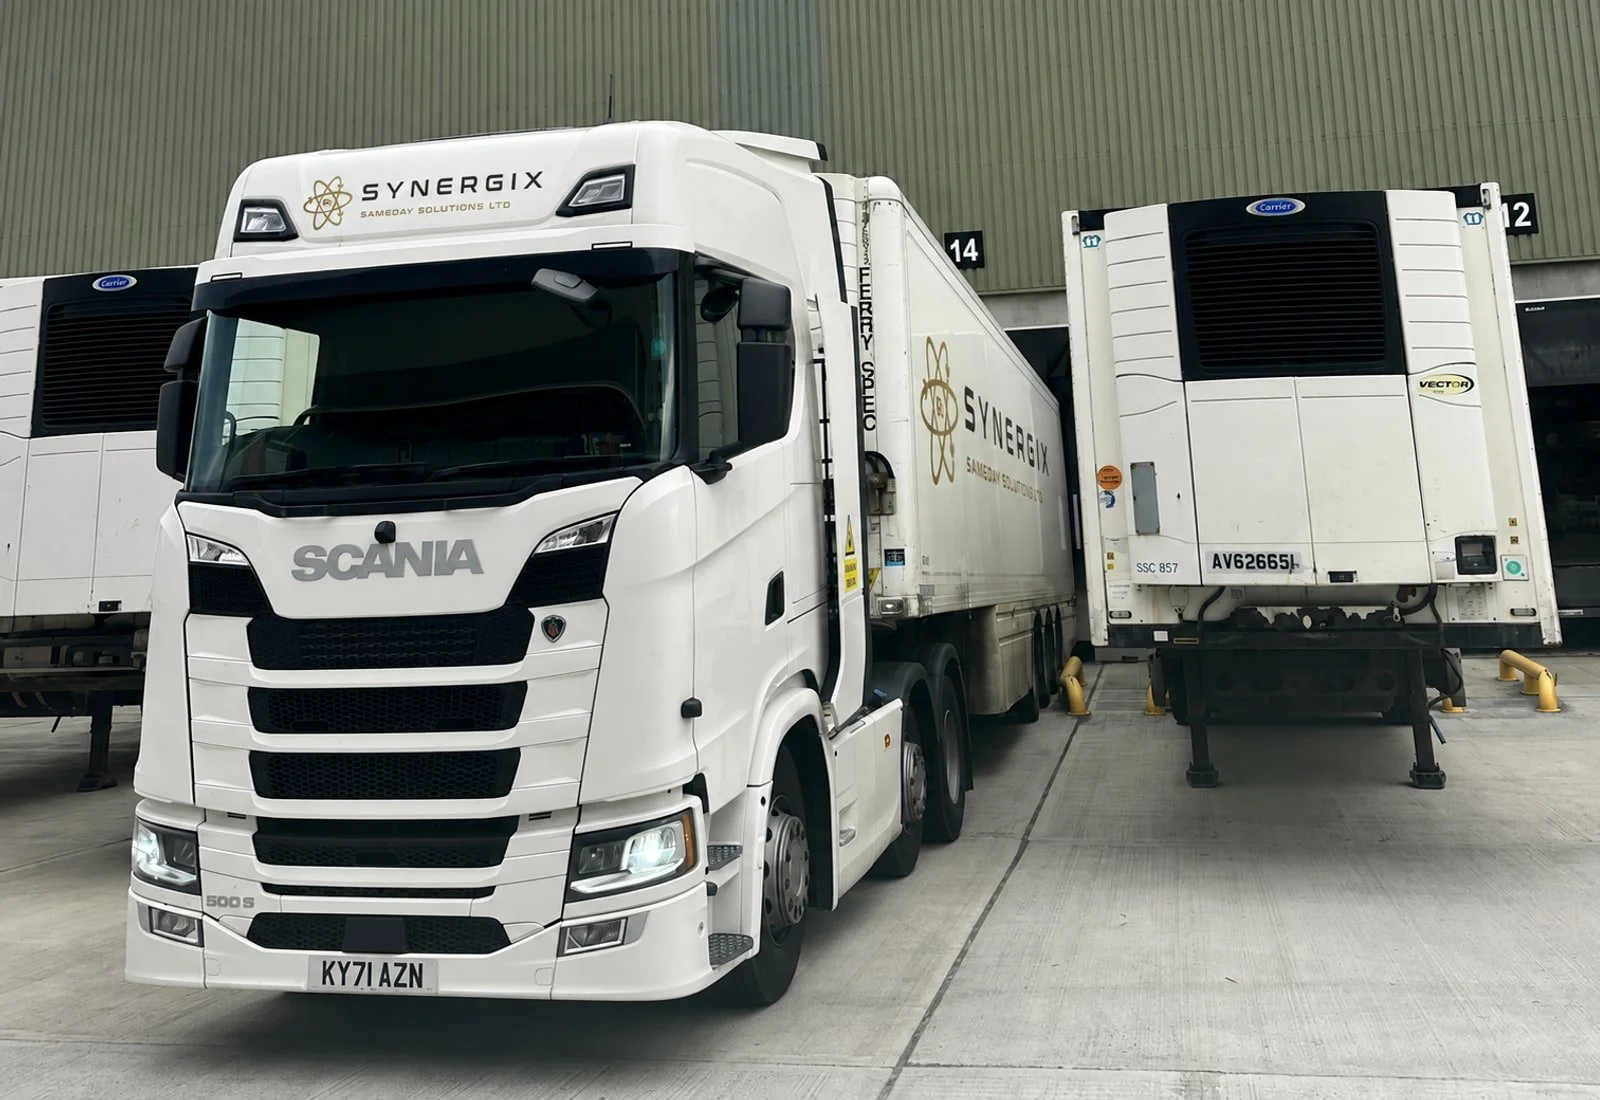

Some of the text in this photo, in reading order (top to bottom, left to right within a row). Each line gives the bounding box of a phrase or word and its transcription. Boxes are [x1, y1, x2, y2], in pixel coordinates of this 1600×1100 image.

[361, 171, 543, 201] SYNERGIX
[360, 201, 511, 218] SAMEDAY SOLUTIONS LTD
[1260, 202, 1292, 211] Carrier
[1501, 202, 1532, 227] 12
[950, 238, 979, 262] 14
[859, 266, 873, 350] FERRY
[861, 361, 876, 432] SPEC
[1419, 380, 1469, 389] VECTOR
[964, 386, 1050, 476] SYNERGIX
[966, 456, 1000, 484] SAMEDAY
[291, 539, 485, 582] SCANIA
[1136, 562, 1179, 573] SSC 857
[206, 895, 255, 908] 500 S
[322, 960, 423, 988] KY71 AZN
